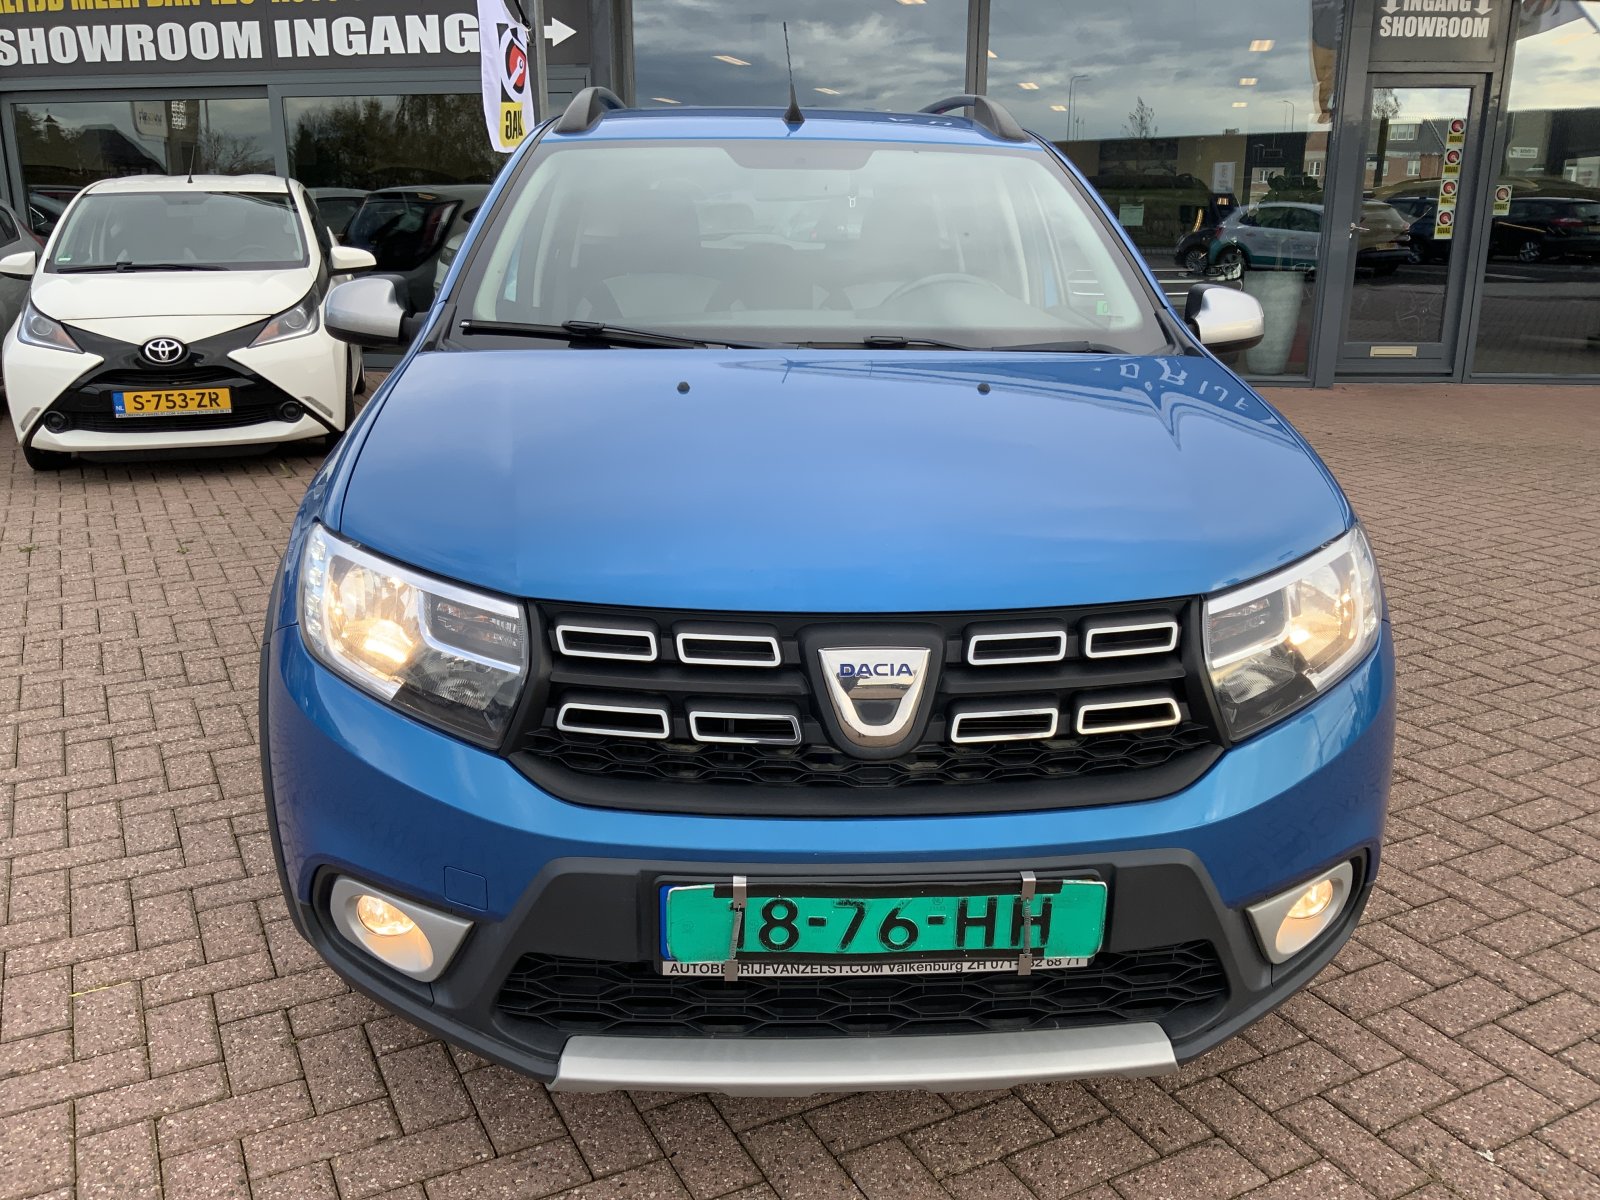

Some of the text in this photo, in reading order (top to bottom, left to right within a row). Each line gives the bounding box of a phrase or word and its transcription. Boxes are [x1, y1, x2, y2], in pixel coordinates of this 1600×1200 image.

[1403, 0, 1471, 12] INGANG
[1379, 16, 1490, 38] SHOWROOM
[0, 13, 480, 66] SHOWROOM INGANG
[132, 391, 221, 411] S-753-ZR
[839, 663, 914, 677] DACIA
[669, 963, 883, 976] AUTOBERIJFVANZELST.COM
[888, 961, 963, 973] Valkenburg
